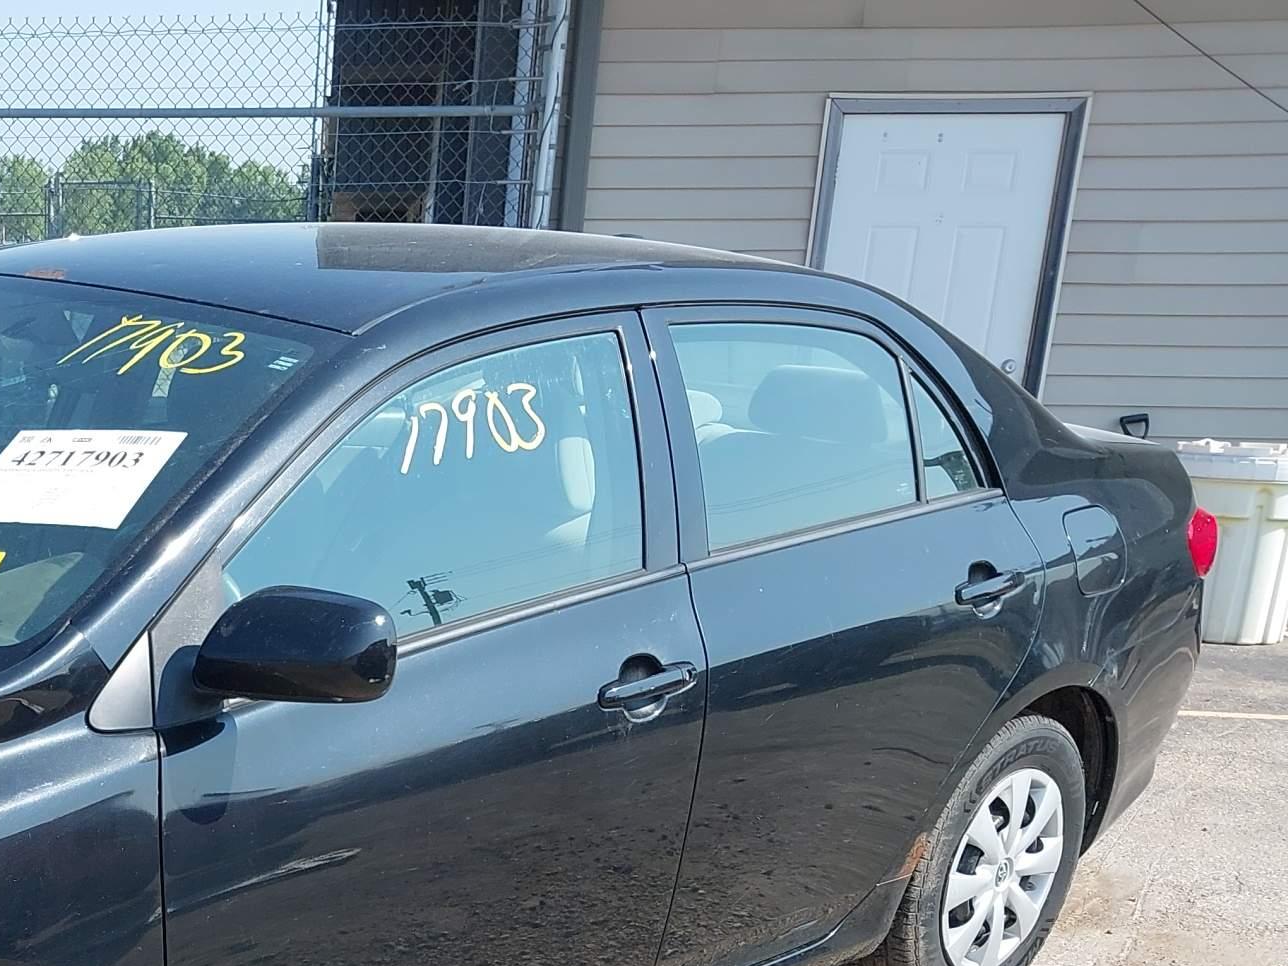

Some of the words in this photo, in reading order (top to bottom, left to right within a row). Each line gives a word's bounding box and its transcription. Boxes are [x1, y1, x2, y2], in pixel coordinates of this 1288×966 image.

[56, 314, 247, 376] 17903
[400, 382, 546, 475] 17903
[11, 449, 145, 469] 42717903
[977, 739, 1058, 791] STRATUS
